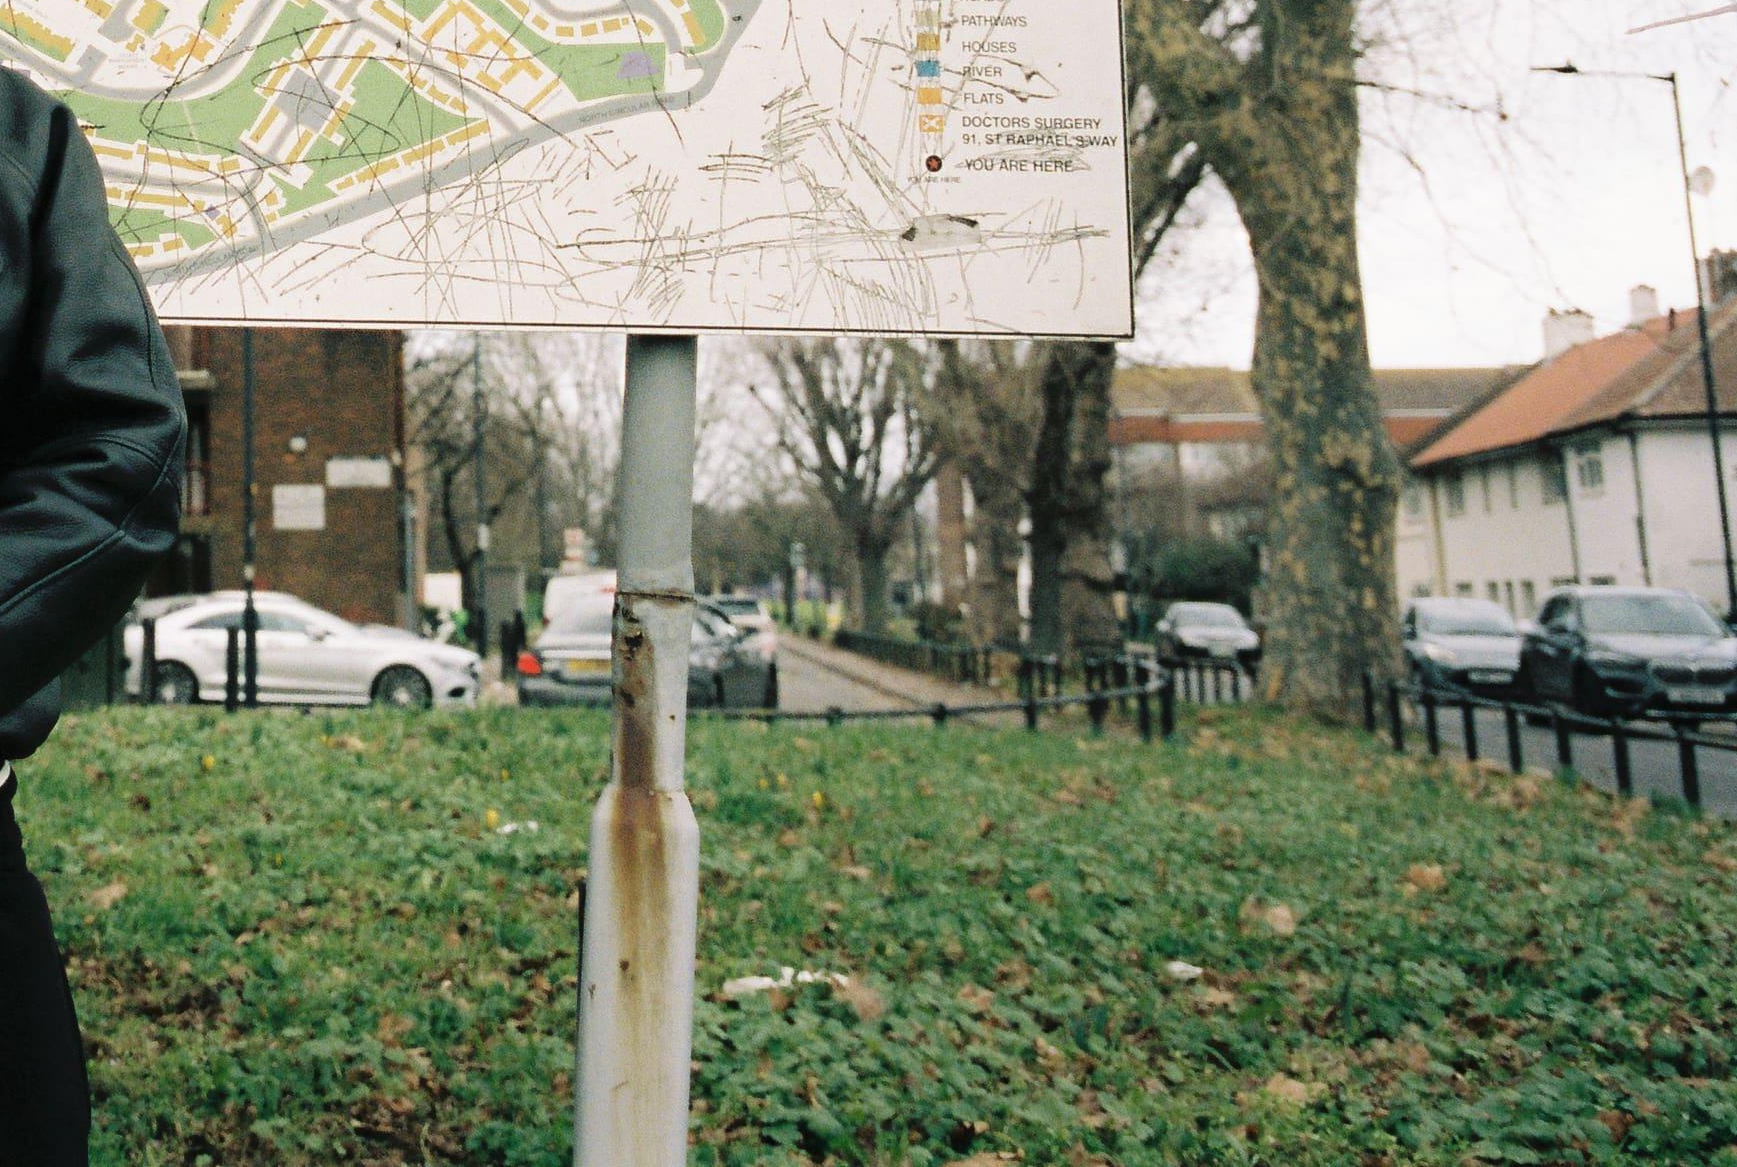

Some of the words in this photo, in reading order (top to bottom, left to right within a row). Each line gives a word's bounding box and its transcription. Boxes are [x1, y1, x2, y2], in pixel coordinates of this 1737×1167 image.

[961, 15, 1027, 27] PATHWAYS
[962, 41, 1017, 53] HOUSES
[963, 66, 1002, 77] RIVER
[964, 93, 1004, 104] FLATS
[962, 116, 1030, 128] DOCTORS
[1034, 117, 1101, 130] SURGERY
[1089, 136, 1118, 147] WAY
[965, 159, 994, 171] YOU
[999, 159, 1030, 171] ARE
[1033, 160, 1075, 172] HERE
